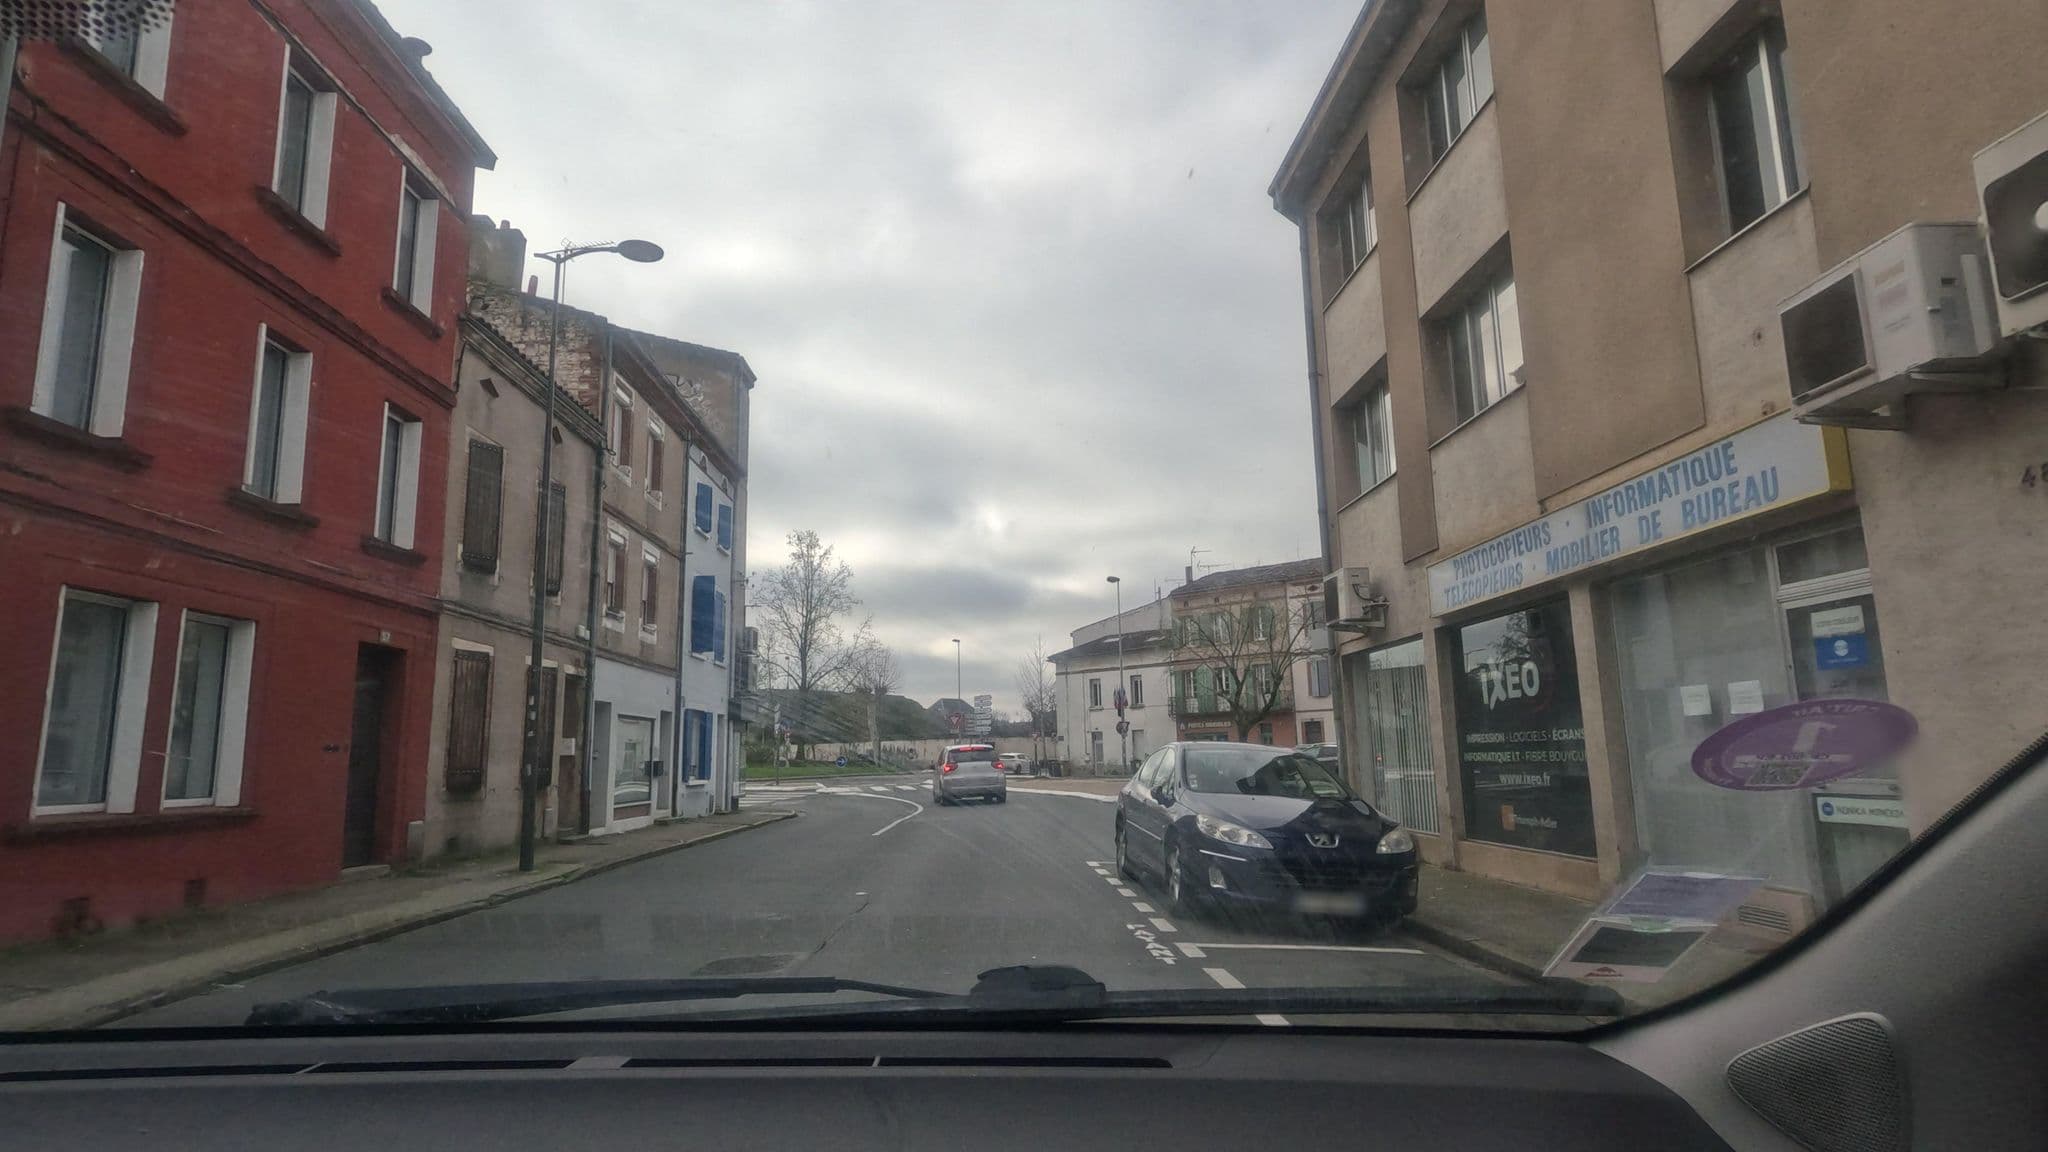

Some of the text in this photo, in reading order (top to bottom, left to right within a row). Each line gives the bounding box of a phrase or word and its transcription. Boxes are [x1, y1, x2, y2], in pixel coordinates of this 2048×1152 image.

[1453, 441, 1738, 580] PHOTOCOPIEURS INFORMATIQUE
[1545, 526, 1621, 576] MOBILIER
[1638, 510, 1663, 545] DE
[1681, 466, 1779, 530] BUREAU
[1466, 733, 1504, 744] IMPRESSION
[1509, 731, 1547, 742] LOGICIELS
